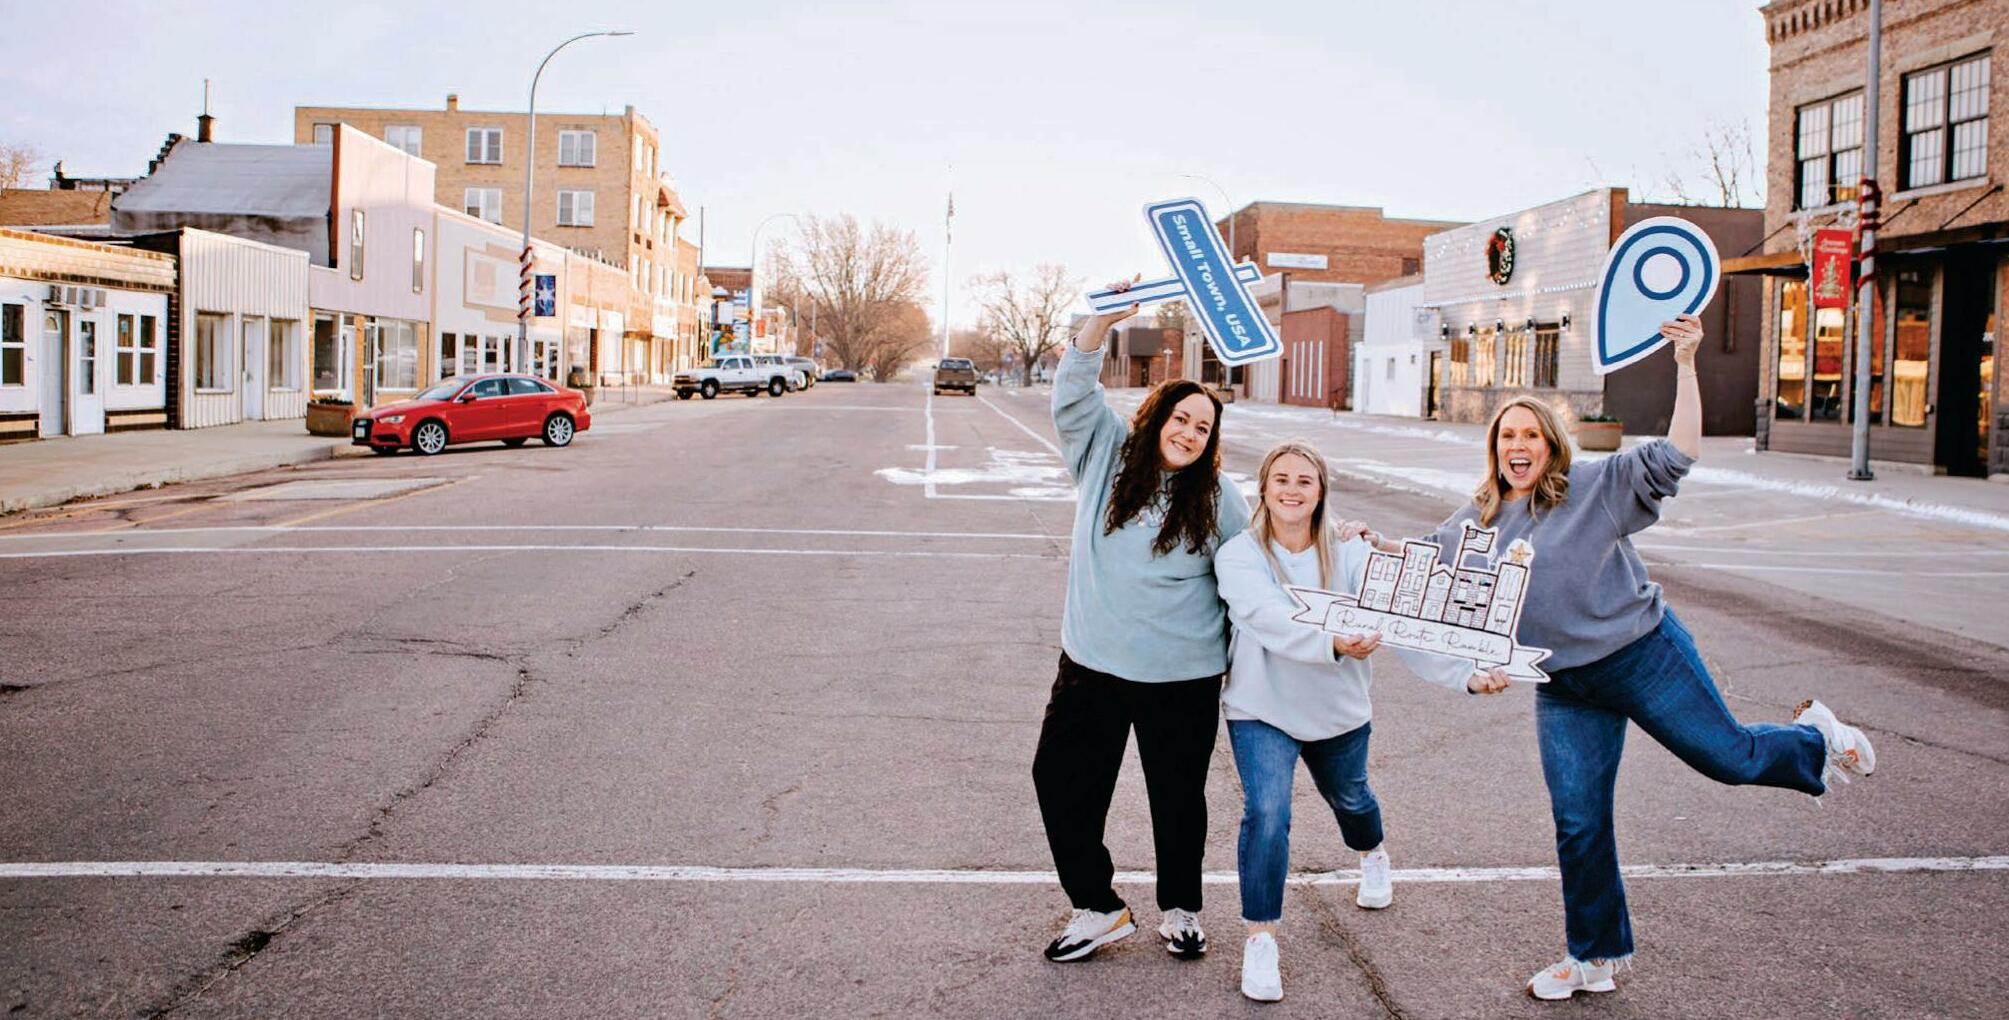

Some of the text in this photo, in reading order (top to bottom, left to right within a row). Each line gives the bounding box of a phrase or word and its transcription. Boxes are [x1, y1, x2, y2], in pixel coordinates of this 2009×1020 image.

[1173, 214, 1252, 348] Small Town, USA
[1336, 609, 1503, 656] Rural Route Ramble
